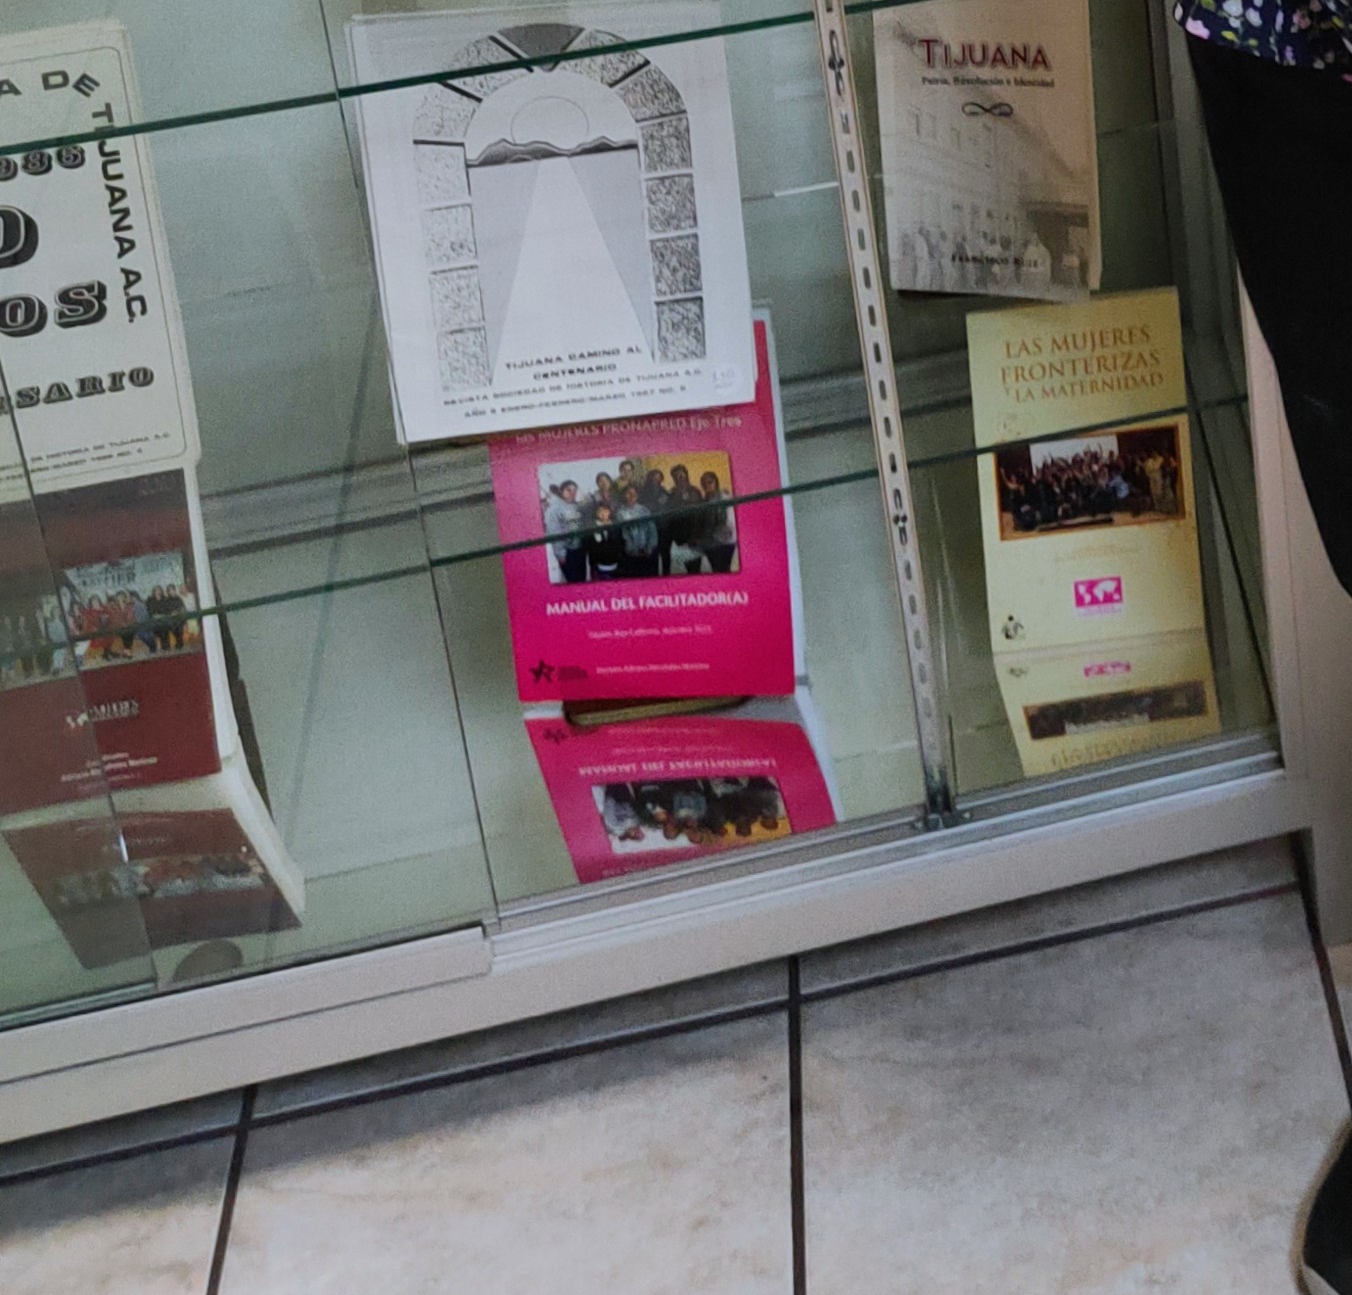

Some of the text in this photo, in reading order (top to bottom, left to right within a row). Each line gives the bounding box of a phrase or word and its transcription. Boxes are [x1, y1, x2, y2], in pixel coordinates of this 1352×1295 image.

[918, 38, 1051, 71] TIJUANA
[41, 69, 100, 97] DE
[505, 344, 643, 371] TIJUANA CAMINO AL
[1004, 324, 1151, 360] LAS MUJERES
[1000, 349, 1162, 385] FRONTERIZAS
[1015, 388, 1035, 403] LA
[1041, 372, 1165, 400] MATERNIDAD
[546, 591, 749, 616] MANUAL DEL FACILITADOR(A)
